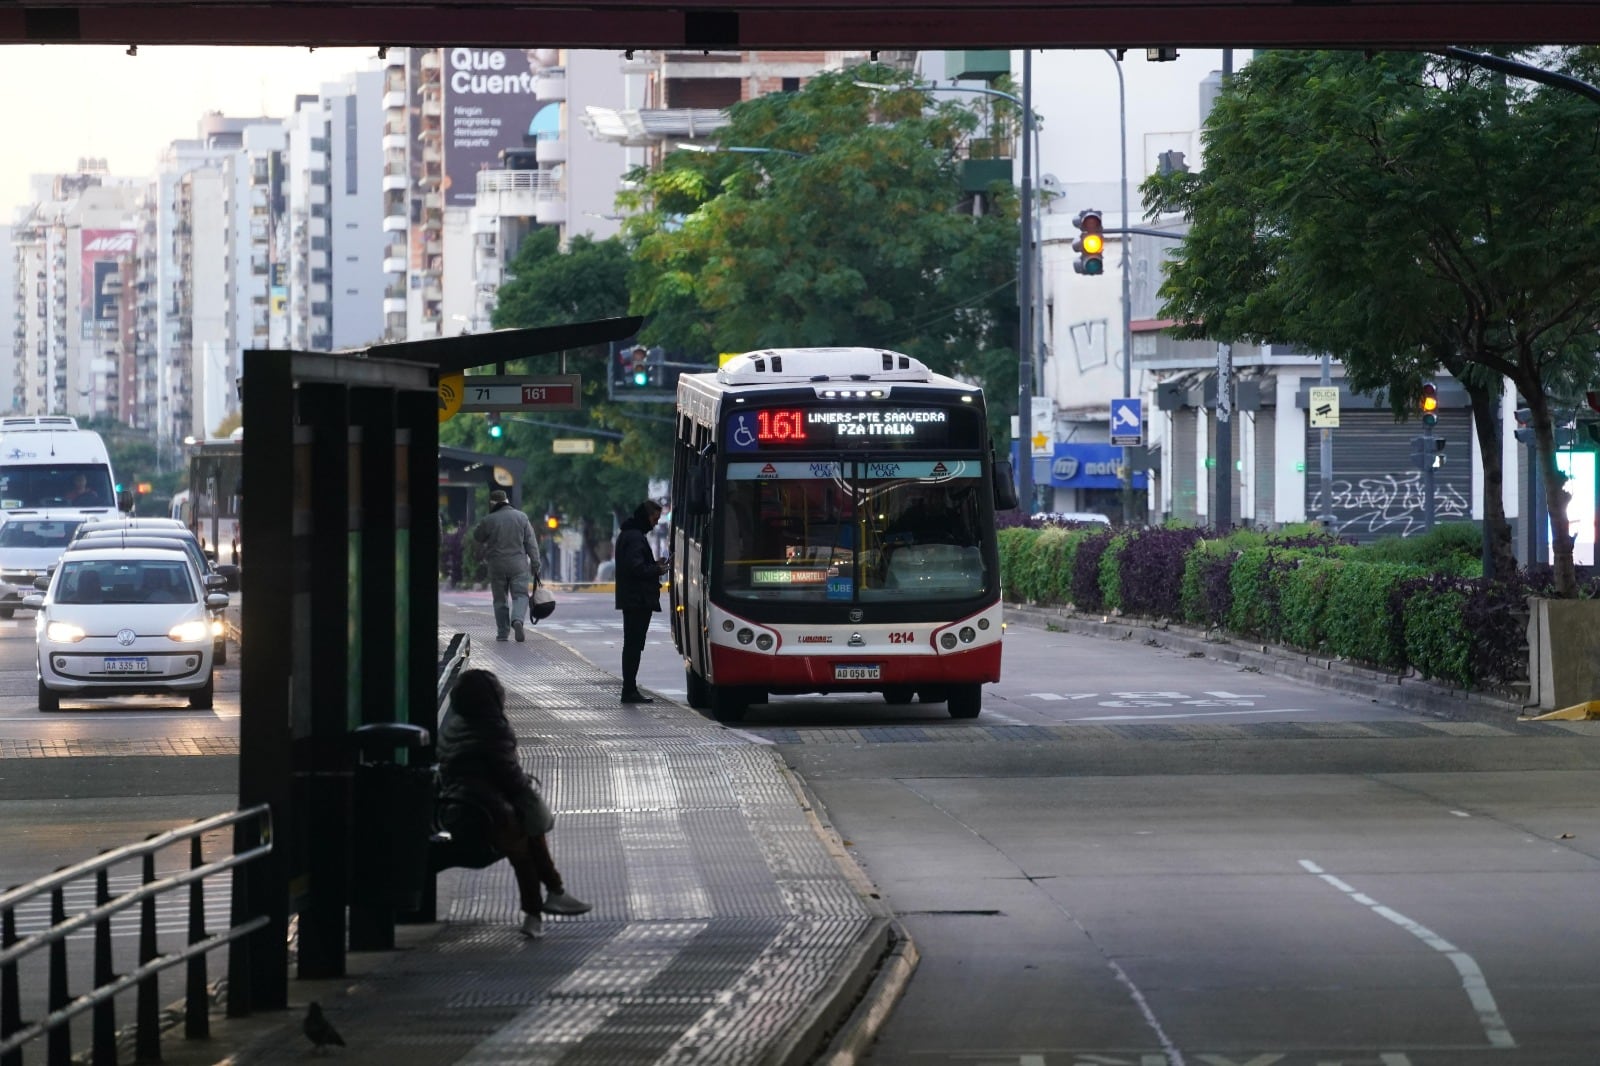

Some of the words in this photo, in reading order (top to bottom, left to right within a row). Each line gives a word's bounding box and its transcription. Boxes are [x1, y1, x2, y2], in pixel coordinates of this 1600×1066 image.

[451, 47, 506, 71] Que
[475, 388, 490, 400] 71
[524, 388, 546, 400] 161
[808, 412, 880, 423] LINIERS-PTE
[884, 412, 945, 422] SAAVEDRA
[758, 411, 806, 439] 161
[838, 423, 866, 435] PZA
[869, 423, 915, 435] ITALIA
[870, 463, 901, 471] MEGA
[875, 469, 896, 477] CAR
[827, 584, 852, 593] SUBE
[888, 632, 914, 643] 1214
[850, 669, 865, 678] 058
[868, 669, 878, 678] VC
